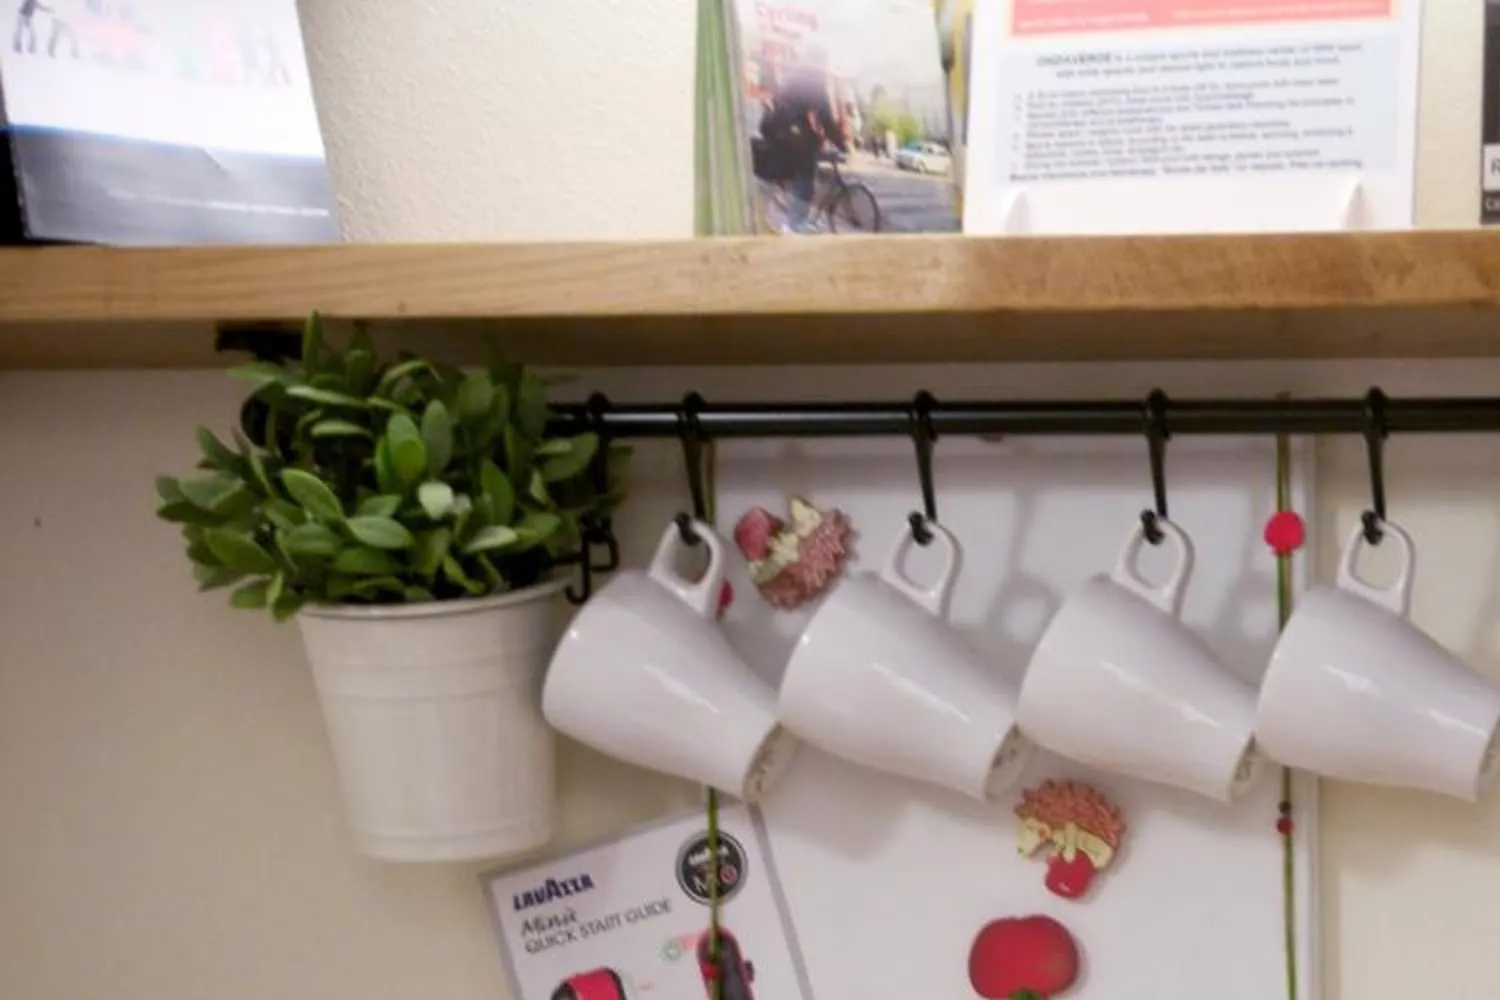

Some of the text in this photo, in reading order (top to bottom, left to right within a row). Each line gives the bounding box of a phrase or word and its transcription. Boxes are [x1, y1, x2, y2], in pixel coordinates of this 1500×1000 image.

[513, 873, 595, 912] LAVAZZA
[525, 896, 672, 954] QUICK START GUIDE
